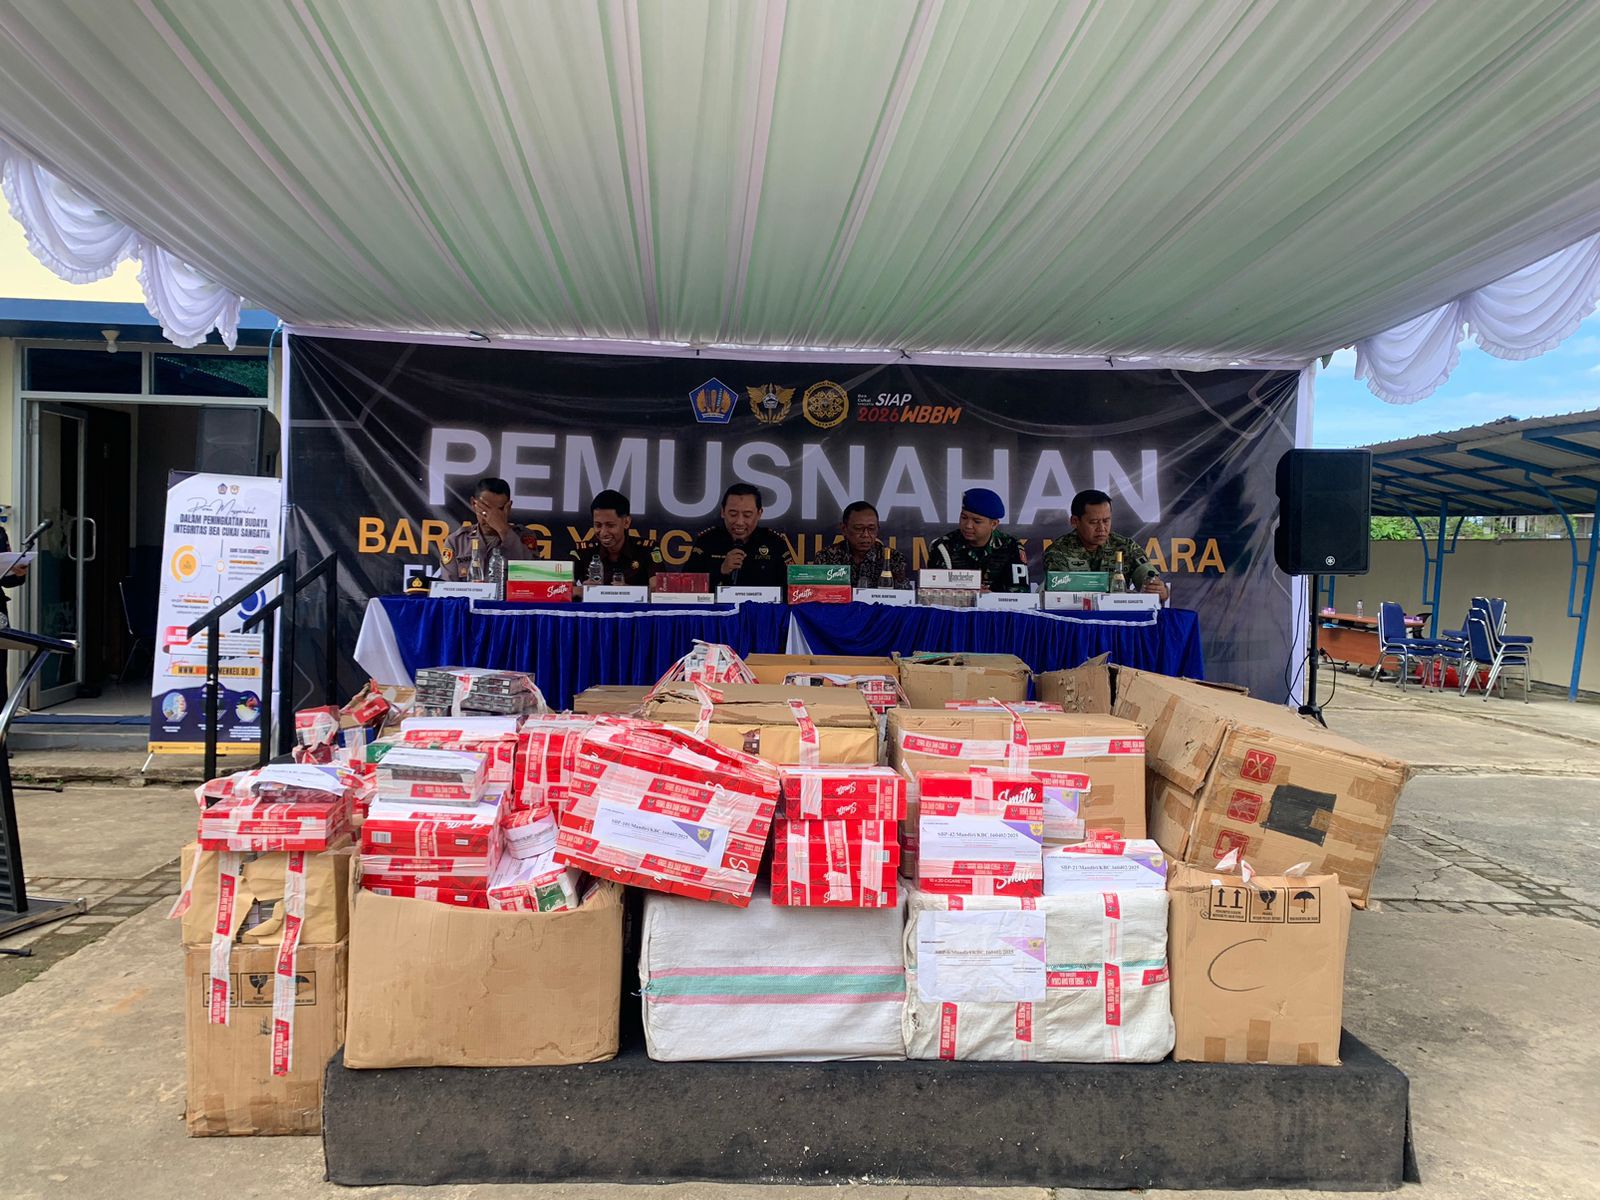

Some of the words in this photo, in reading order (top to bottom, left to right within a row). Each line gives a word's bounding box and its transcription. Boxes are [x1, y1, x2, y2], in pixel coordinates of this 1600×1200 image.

[875, 393, 912, 407] SIAP
[857, 406, 900, 423] 2026
[900, 405, 962, 425] WBBM
[428, 427, 1162, 525] PEMUSNAHAN
[180, 514, 202, 523] DALAM
[203, 515, 244, 527] PENINGKATAN
[244, 517, 268, 528] BUDAYA
[173, 524, 208, 535] INTEGRITAS
[208, 526, 221, 536] BEA
[222, 527, 240, 537] CUKAI
[240, 528, 271, 539] SANGATTA
[826, 568, 847, 580] Smith
[1051, 574, 1072, 587] Smith
[546, 584, 569, 597] Smith
[792, 588, 813, 602] Smith
[997, 787, 1037, 811] Smith
